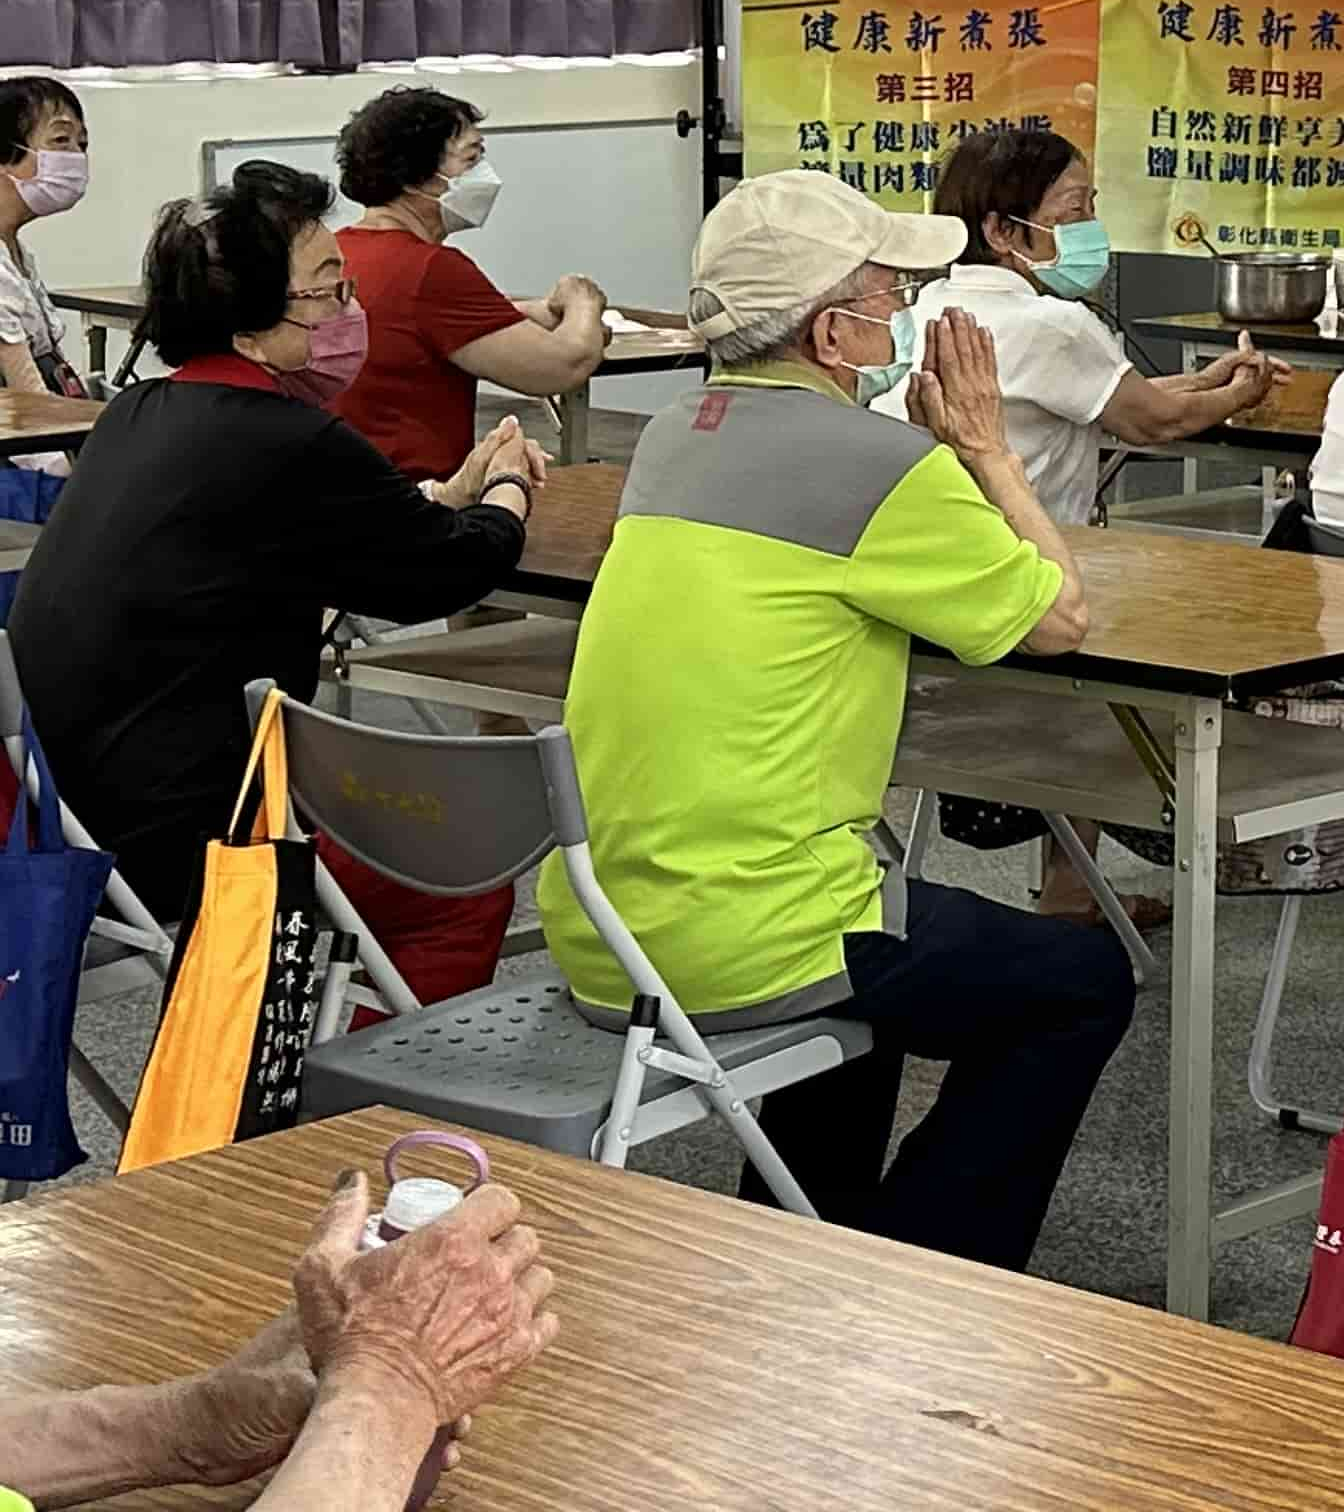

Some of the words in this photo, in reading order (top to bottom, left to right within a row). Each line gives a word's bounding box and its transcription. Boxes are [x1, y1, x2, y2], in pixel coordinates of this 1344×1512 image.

[800, 7, 1047, 55] 健康新煮張
[875, 73, 975, 105] 第三招
[1227, 66, 1324, 100] 第四招
[1217, 224, 1341, 249] 彰化縣衛生局
